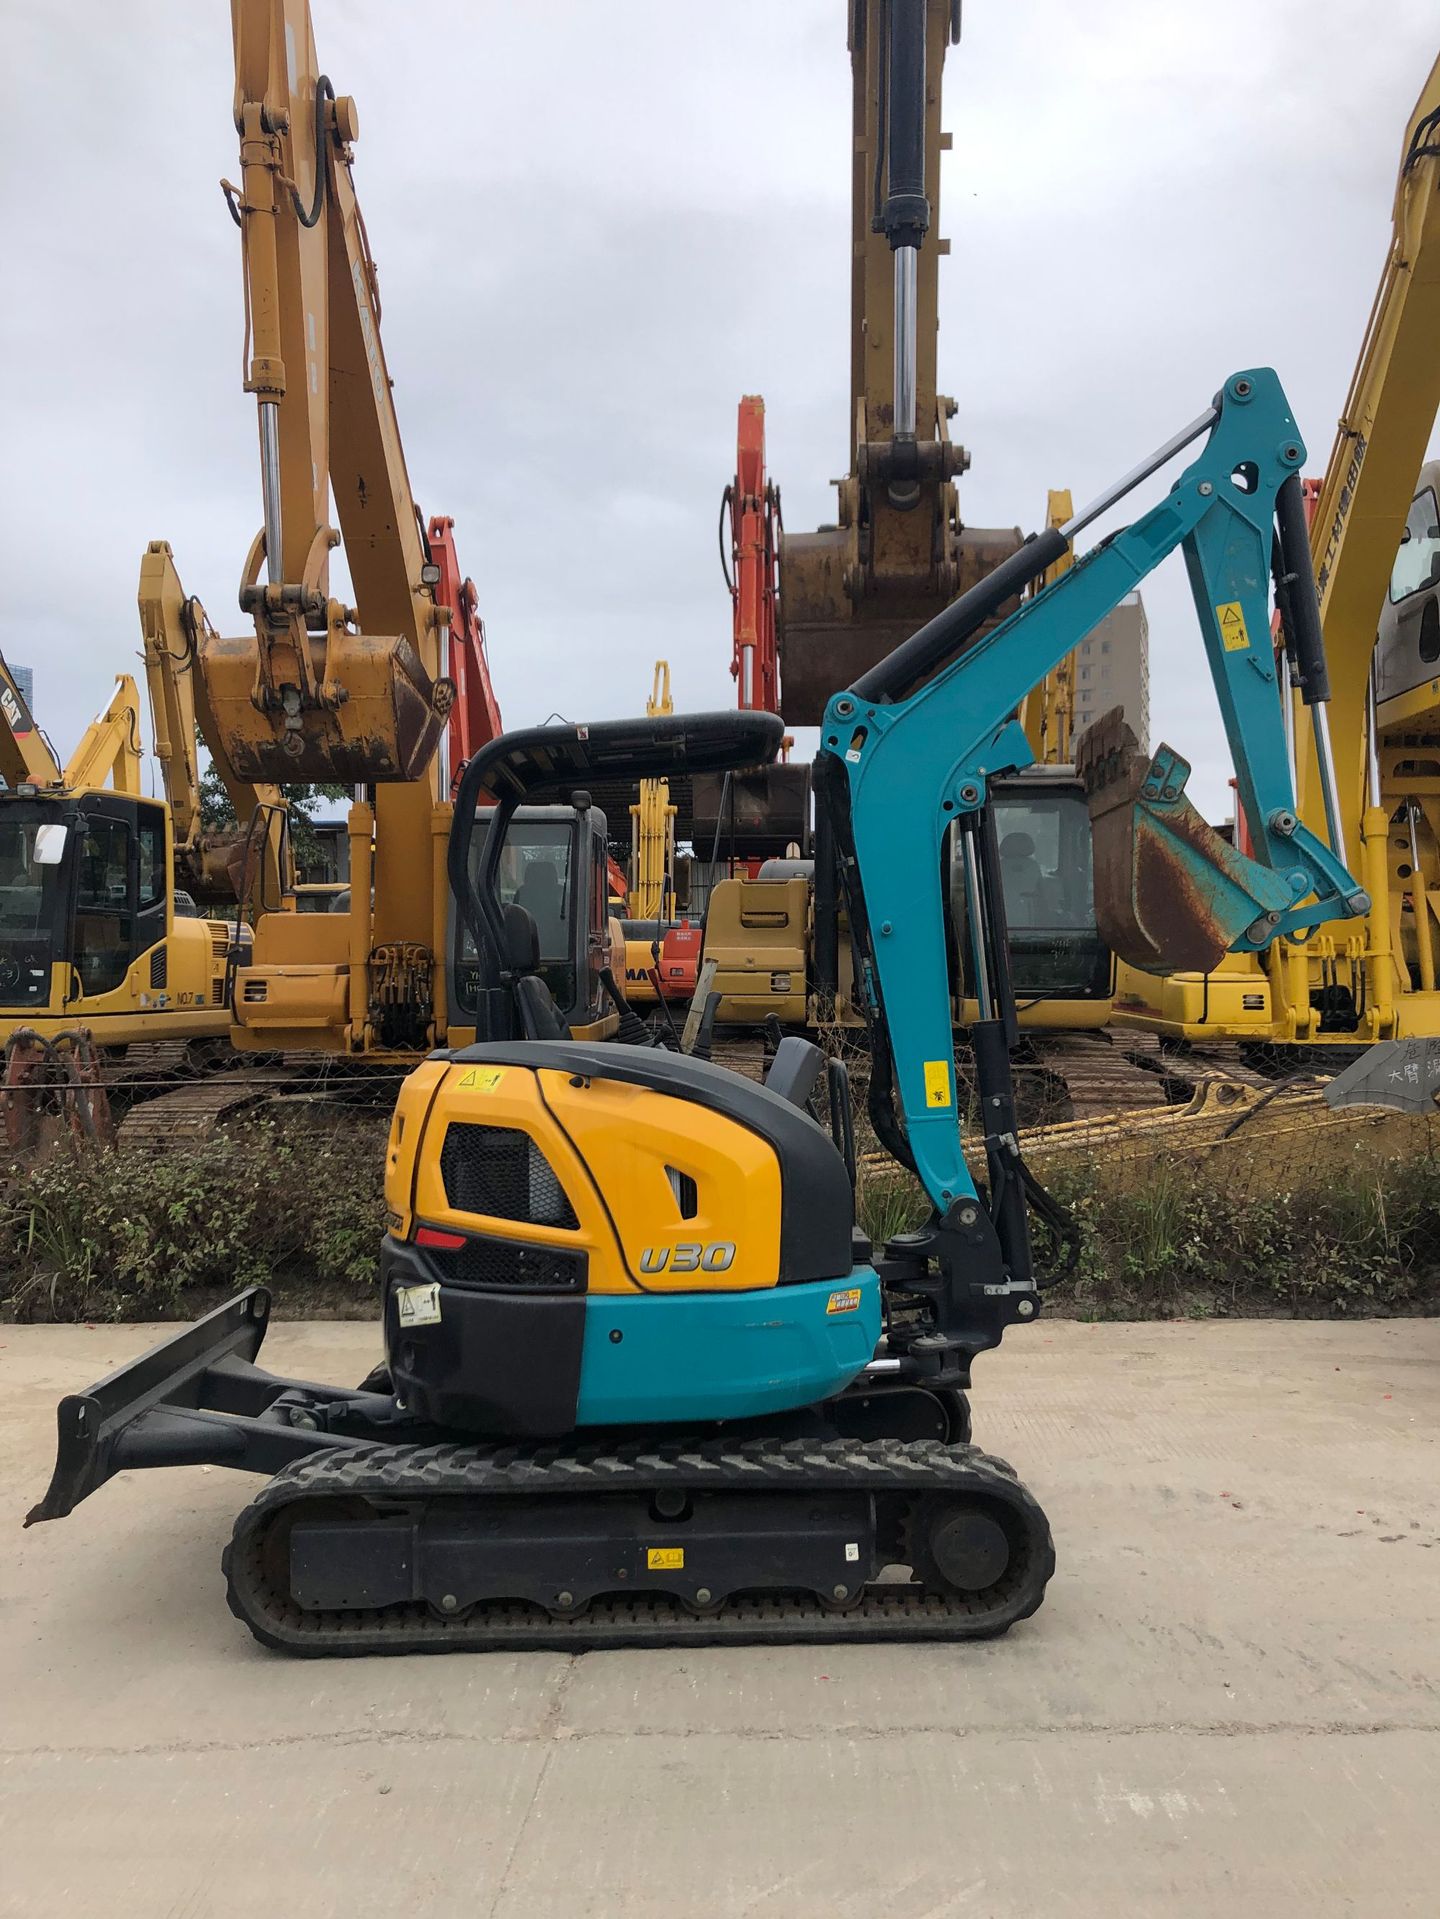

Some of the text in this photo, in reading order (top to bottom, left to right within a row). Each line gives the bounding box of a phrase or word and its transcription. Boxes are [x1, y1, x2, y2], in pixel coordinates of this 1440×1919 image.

[352, 258, 384, 404] KATO
[1, 687, 22, 727] CAT
[640, 1241, 737, 1273] U30
